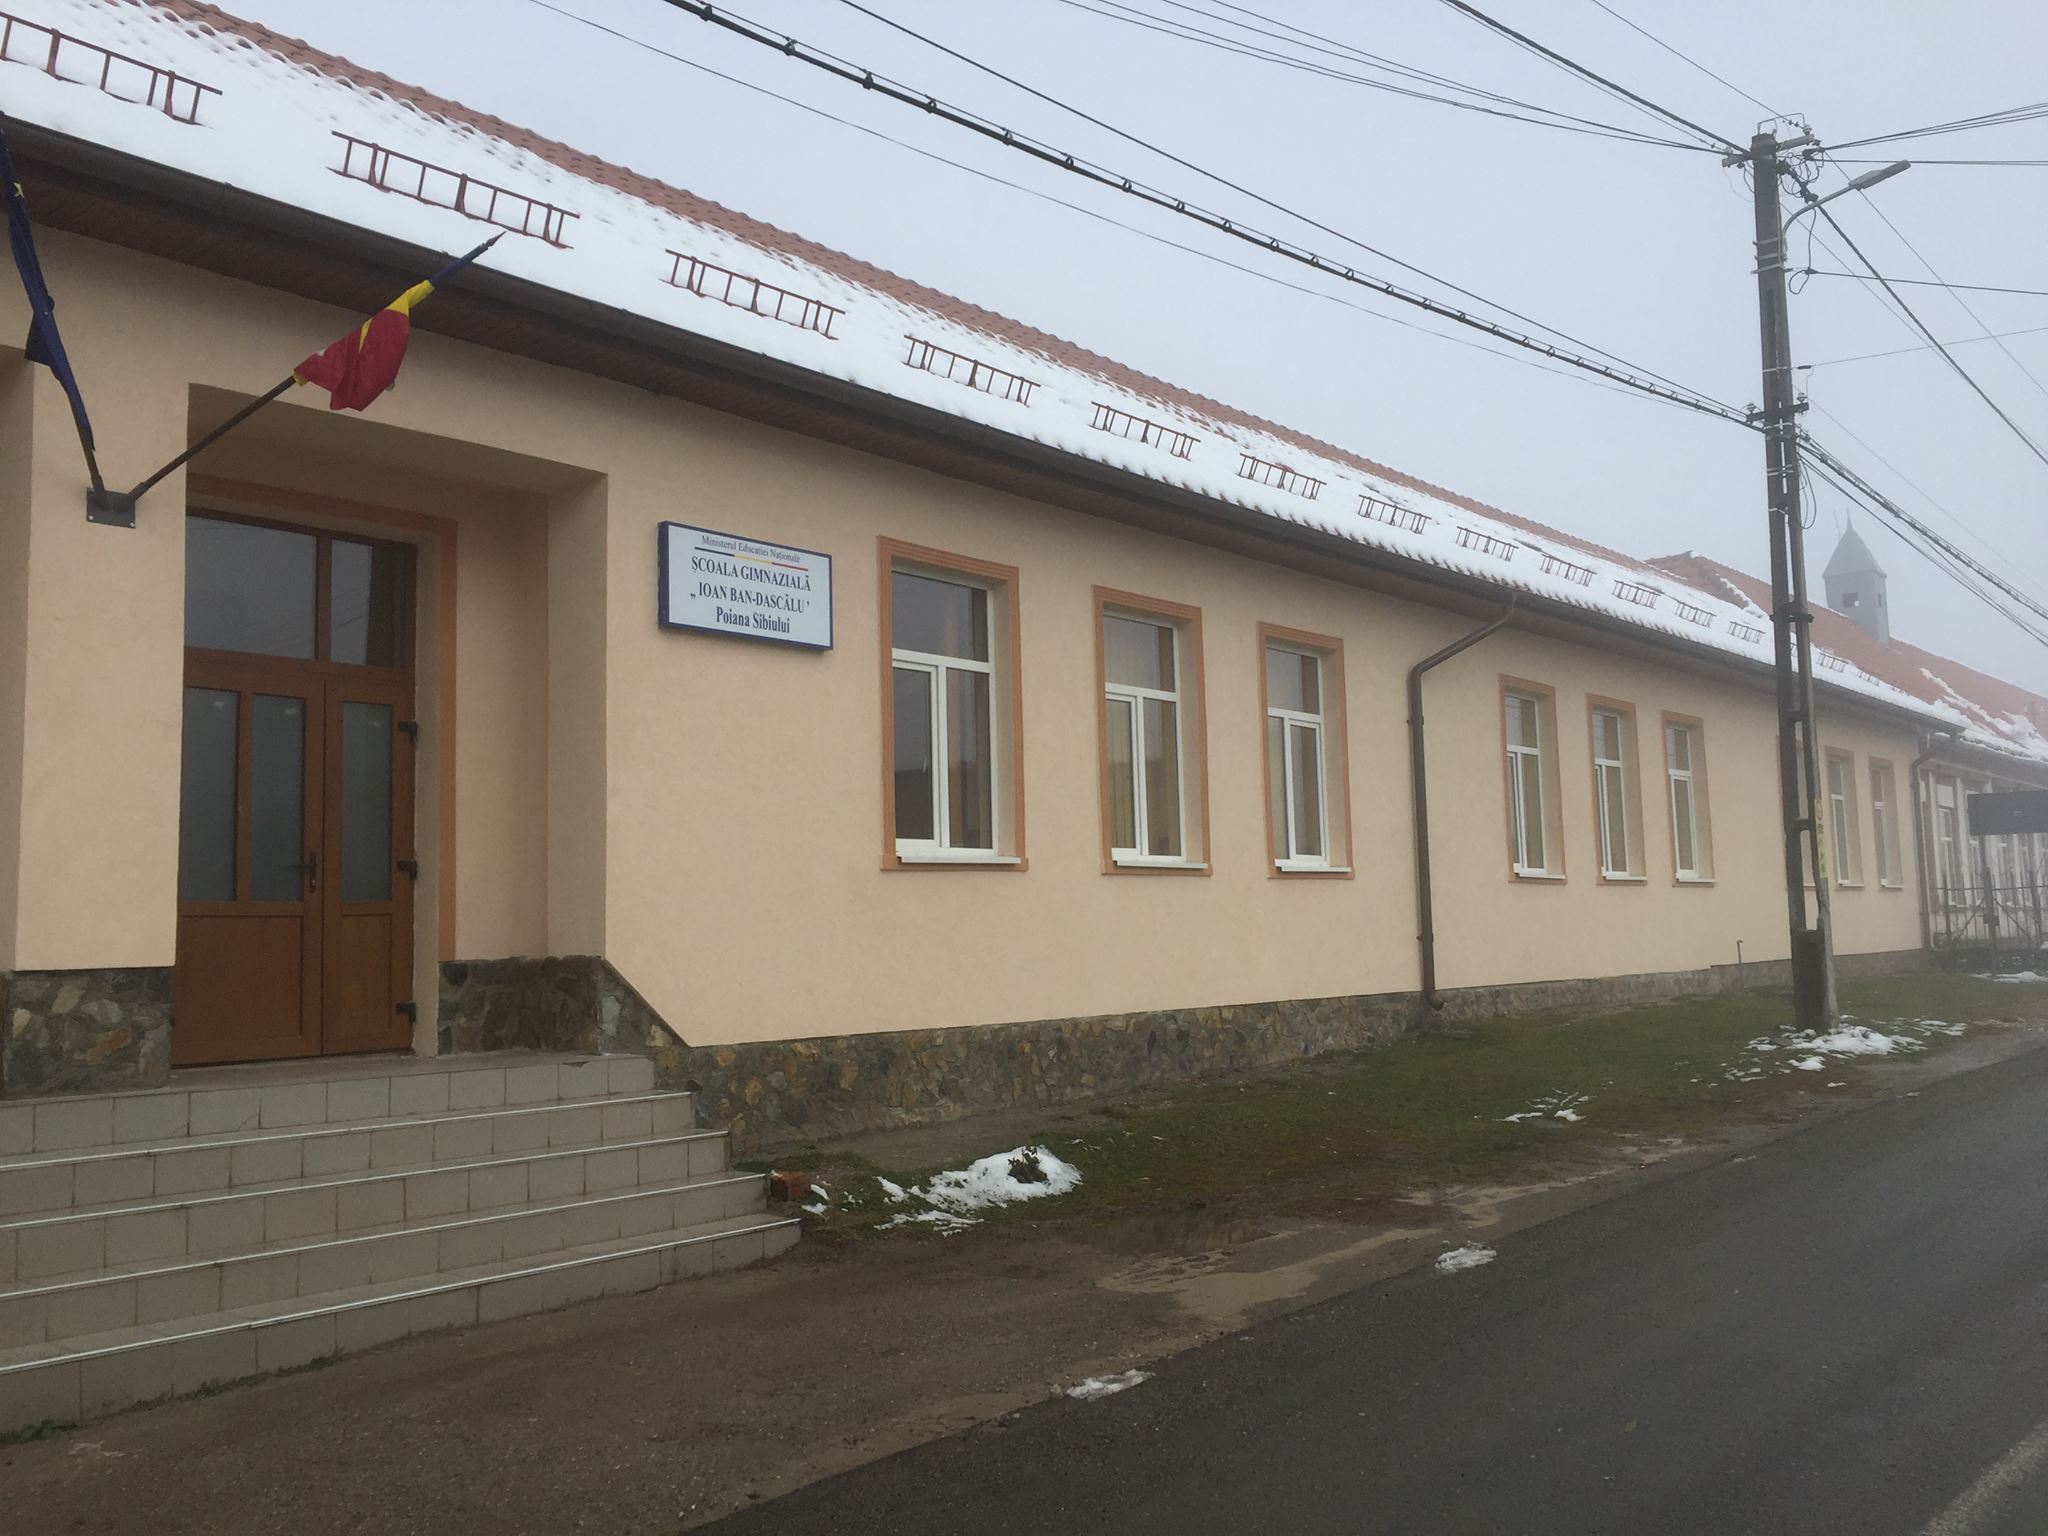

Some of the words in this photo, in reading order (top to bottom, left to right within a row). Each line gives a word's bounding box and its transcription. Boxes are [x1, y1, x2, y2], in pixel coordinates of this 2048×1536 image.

[702, 536, 736, 551] Ministerul
[691, 556, 738, 578] ȘCOALA
[716, 606, 750, 627] Poiana
[752, 612, 790, 633] Sibiului
